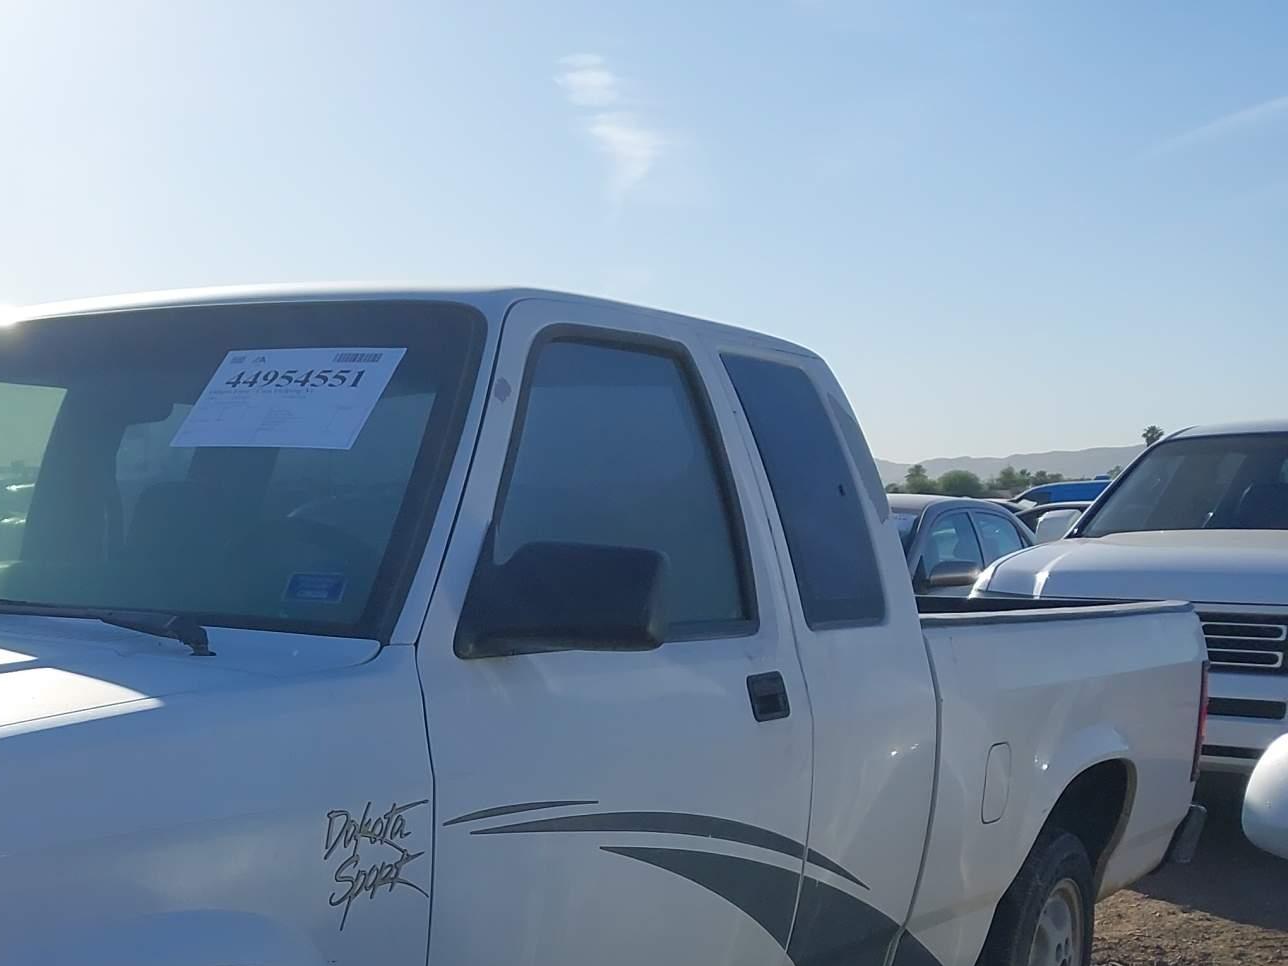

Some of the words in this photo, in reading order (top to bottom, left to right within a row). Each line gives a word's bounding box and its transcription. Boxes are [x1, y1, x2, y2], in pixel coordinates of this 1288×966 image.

[225, 369, 366, 388] 44954551
[324, 799, 429, 860] Dakota
[328, 852, 429, 931] Sport
